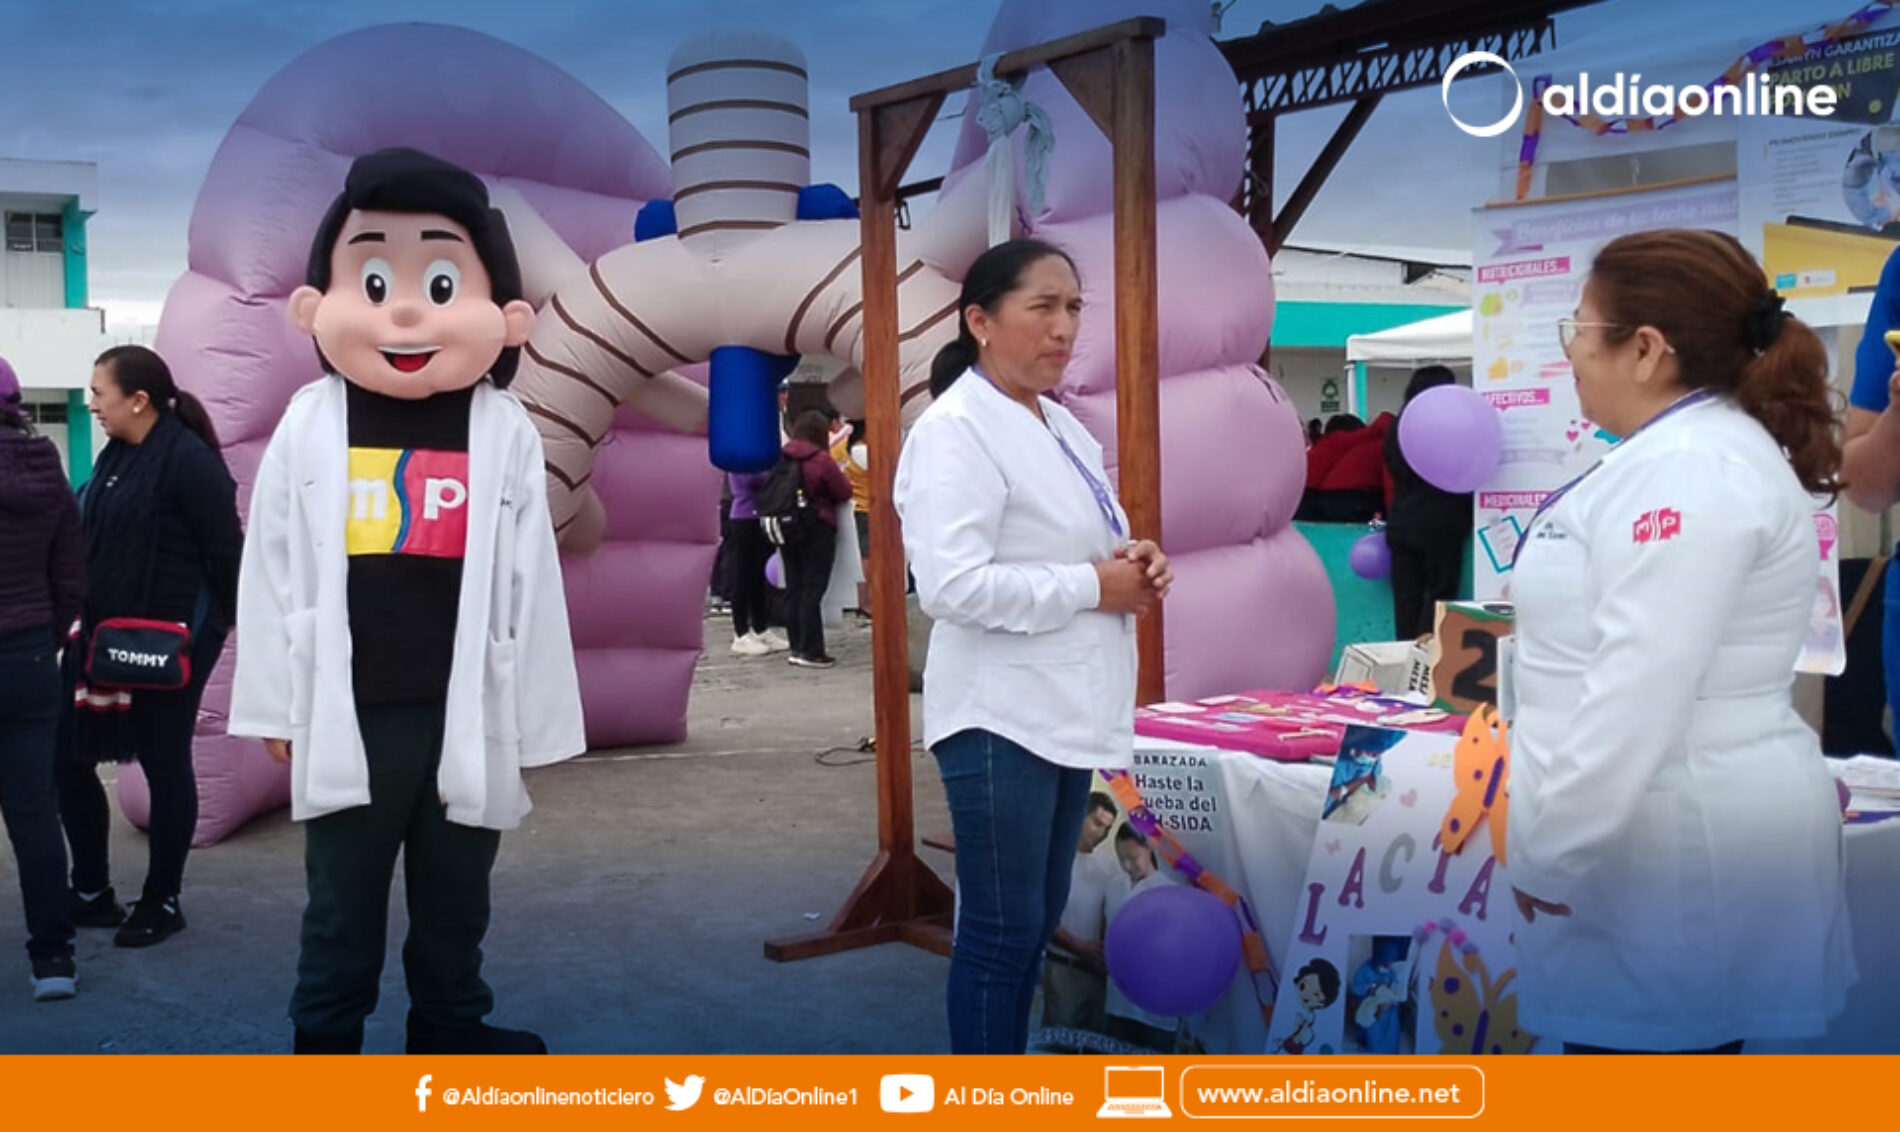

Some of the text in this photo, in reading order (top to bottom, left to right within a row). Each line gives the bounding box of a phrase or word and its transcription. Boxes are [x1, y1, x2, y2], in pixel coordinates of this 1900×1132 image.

[1829, 62, 1844, 78] A
[1847, 52, 1895, 75] LIBRE
[107, 648, 169, 667] TOMMY
[1452, 629, 1497, 706] 2
[1135, 773, 1204, 791] Haste la
[1140, 795, 1216, 812] ueba del
